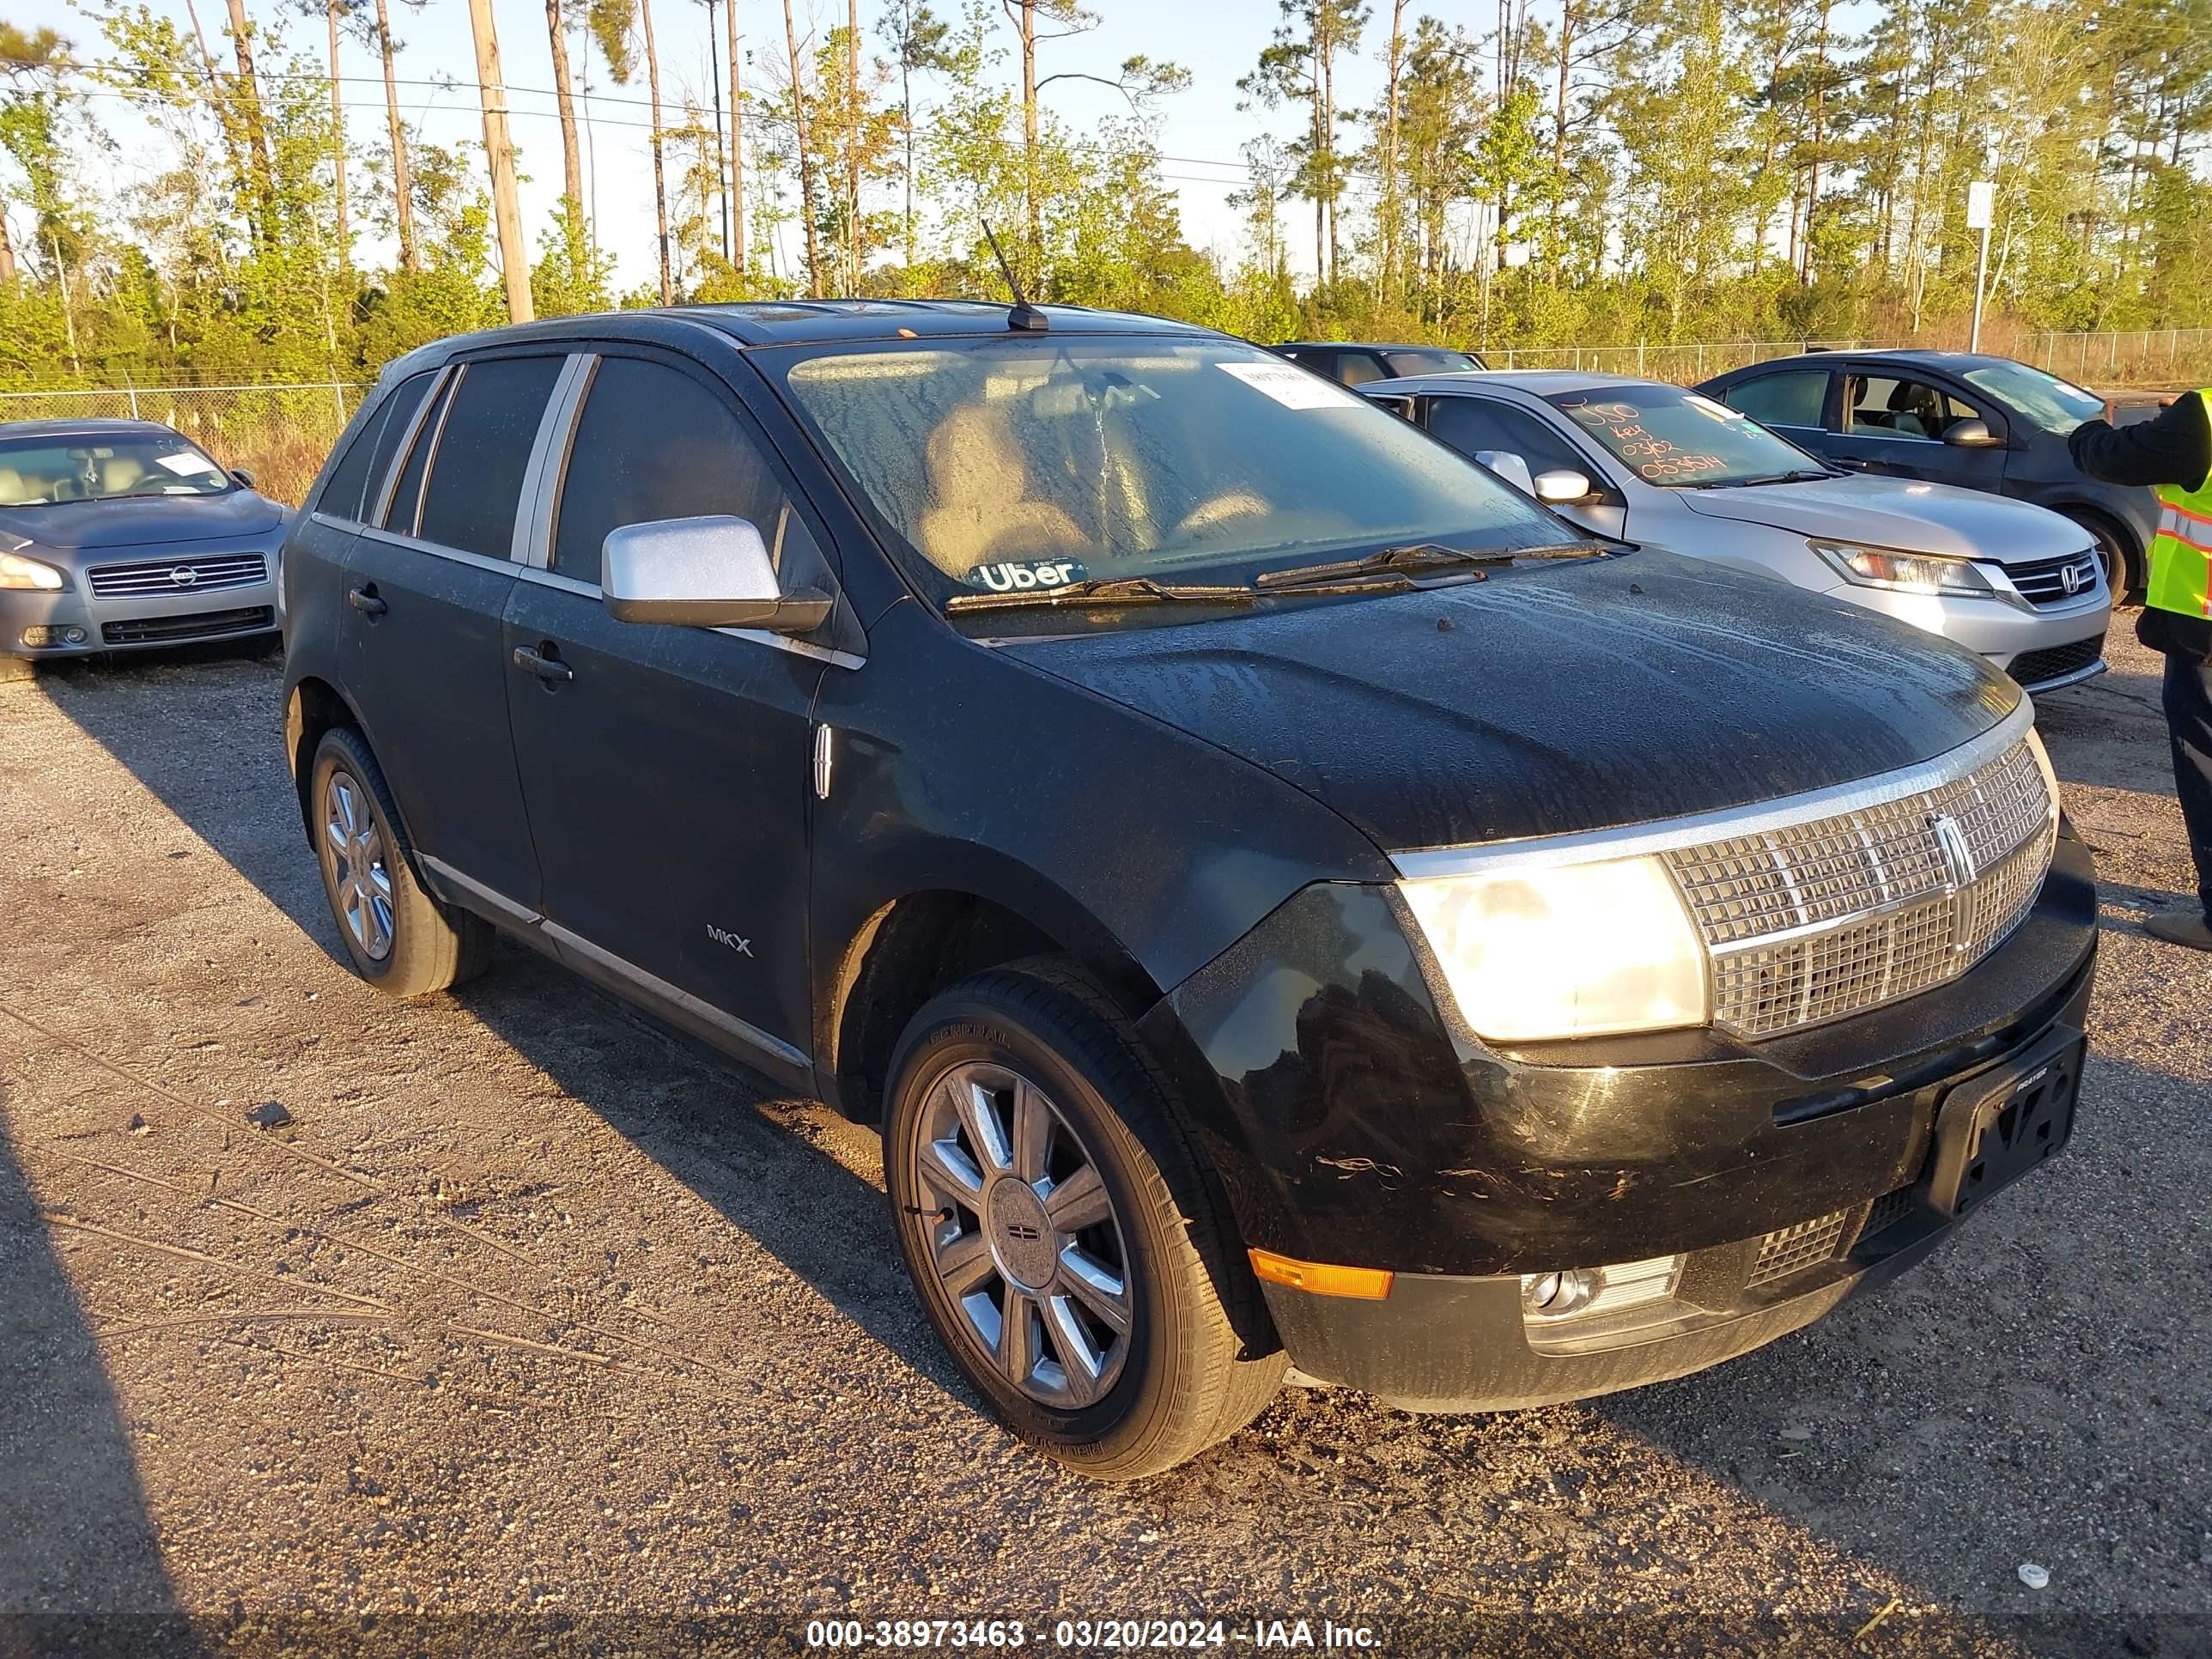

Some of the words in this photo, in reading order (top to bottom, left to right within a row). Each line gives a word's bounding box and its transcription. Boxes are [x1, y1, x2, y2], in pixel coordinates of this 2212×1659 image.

[1641, 455, 1727, 478] 053574
[979, 562, 1074, 592] Uber
[707, 924, 755, 958] MKX
